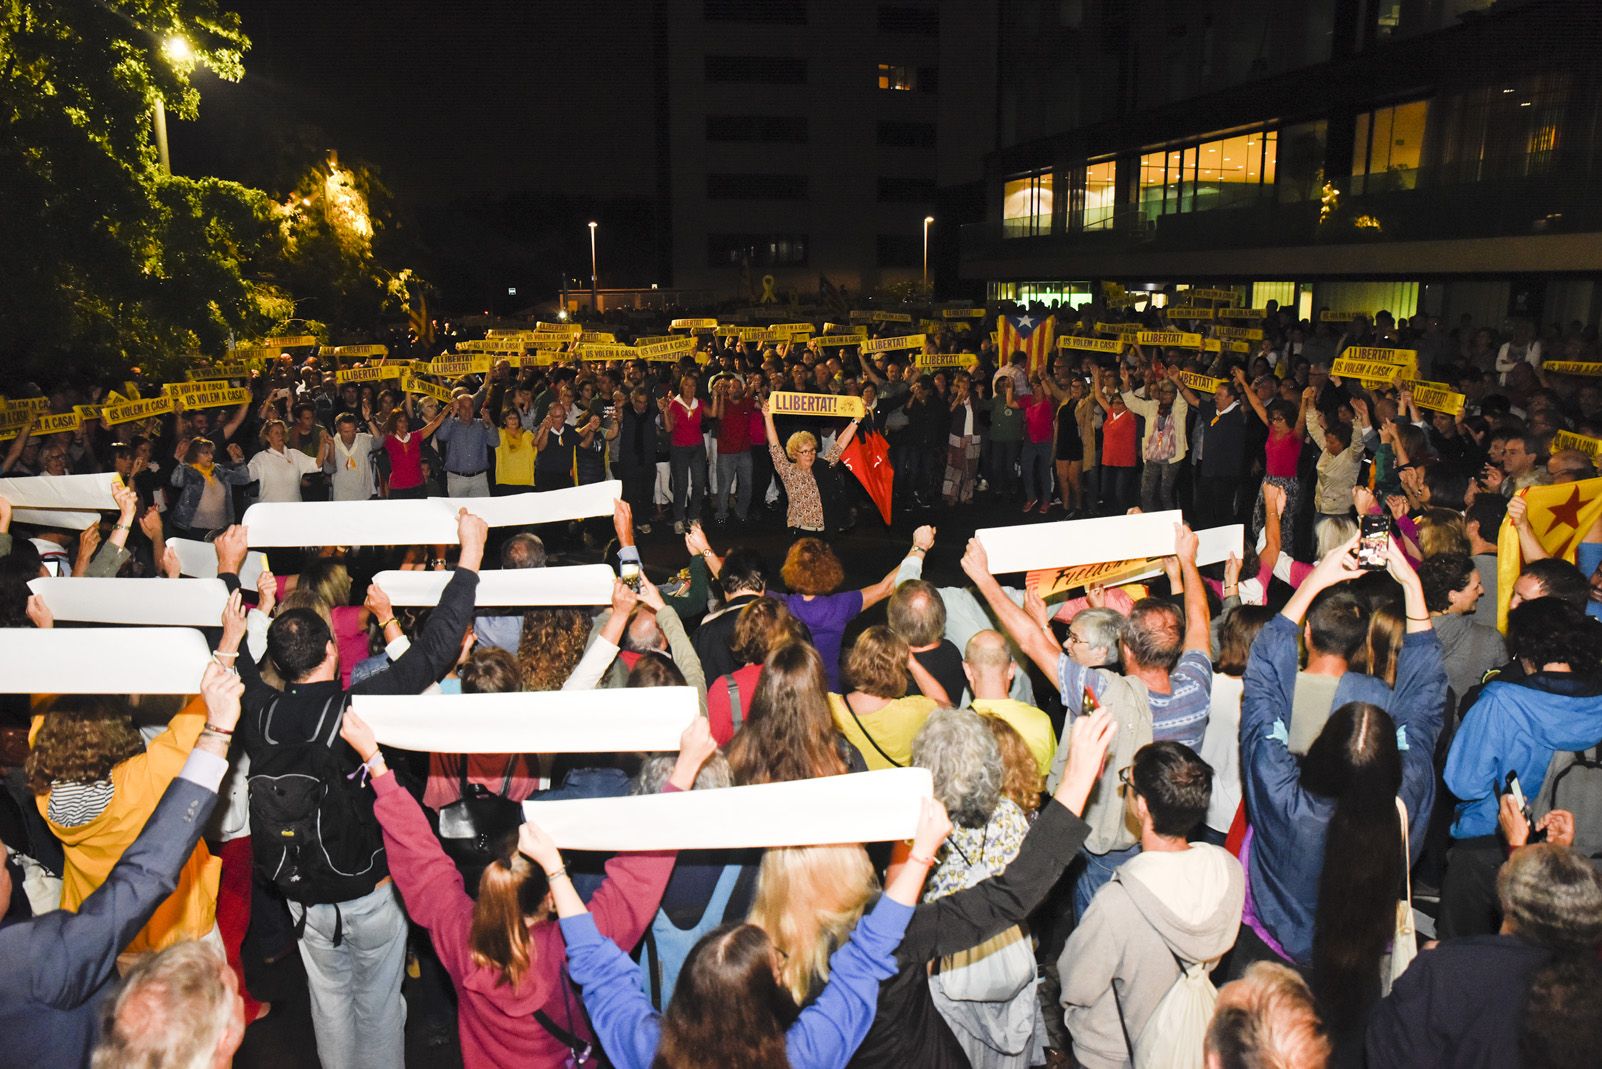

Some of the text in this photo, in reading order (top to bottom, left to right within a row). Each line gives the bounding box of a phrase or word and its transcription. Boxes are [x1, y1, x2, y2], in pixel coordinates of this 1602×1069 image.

[867, 338, 907, 350] LLIBERTAT!
[1142, 333, 1183, 343] LLIBERTAT!
[1100, 342, 1118, 350] CASA!
[921, 355, 960, 365] LLIBERTAT!
[1349, 348, 1395, 361] LLIBERTAT!
[342, 368, 382, 380] LLIBERTAT!
[432, 363, 472, 374] LLIBERTAT!
[1334, 361, 1342, 371] US
[1344, 362, 1364, 374] VOLEM
[1366, 366, 1371, 374] A
[1372, 366, 1393, 377] CASA!
[186, 390, 245, 405] US VOLEM A CASA!
[776, 394, 837, 412] LLIBERTAT!
[1415, 386, 1448, 407] LLIBERTAT!
[110, 399, 170, 420] US VOLEM A CASA!
[45, 420, 50, 429] A
[52, 415, 76, 427] CASA!
